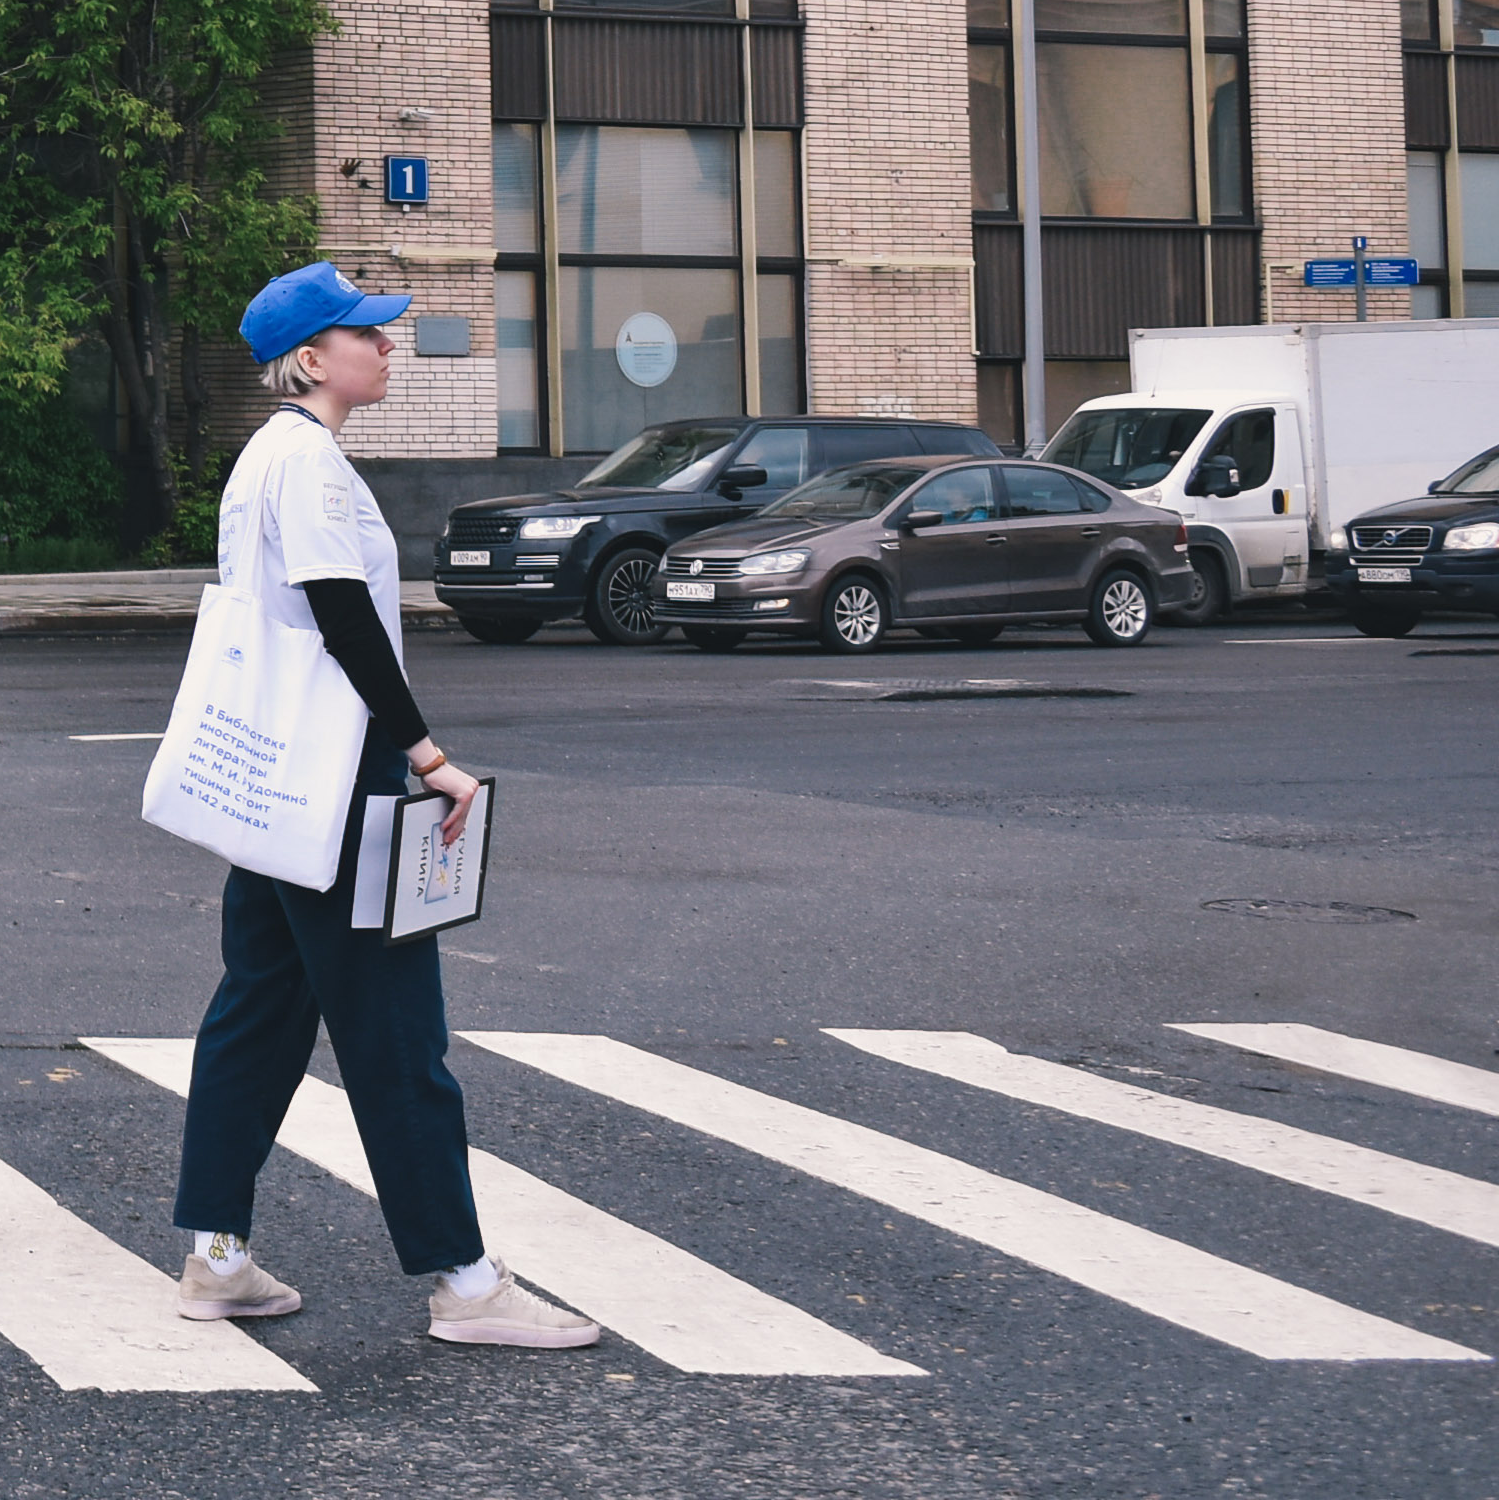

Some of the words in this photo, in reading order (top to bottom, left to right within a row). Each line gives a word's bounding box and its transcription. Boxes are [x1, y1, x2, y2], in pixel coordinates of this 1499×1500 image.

[402, 164, 414, 194] 1
[205, 704, 214, 715] В
[188, 752, 207, 767] им.
[184, 767, 231, 796] тишина
[179, 782, 194, 795] на
[221, 804, 270, 830] языках
[416, 836, 429, 898] КНИГА
